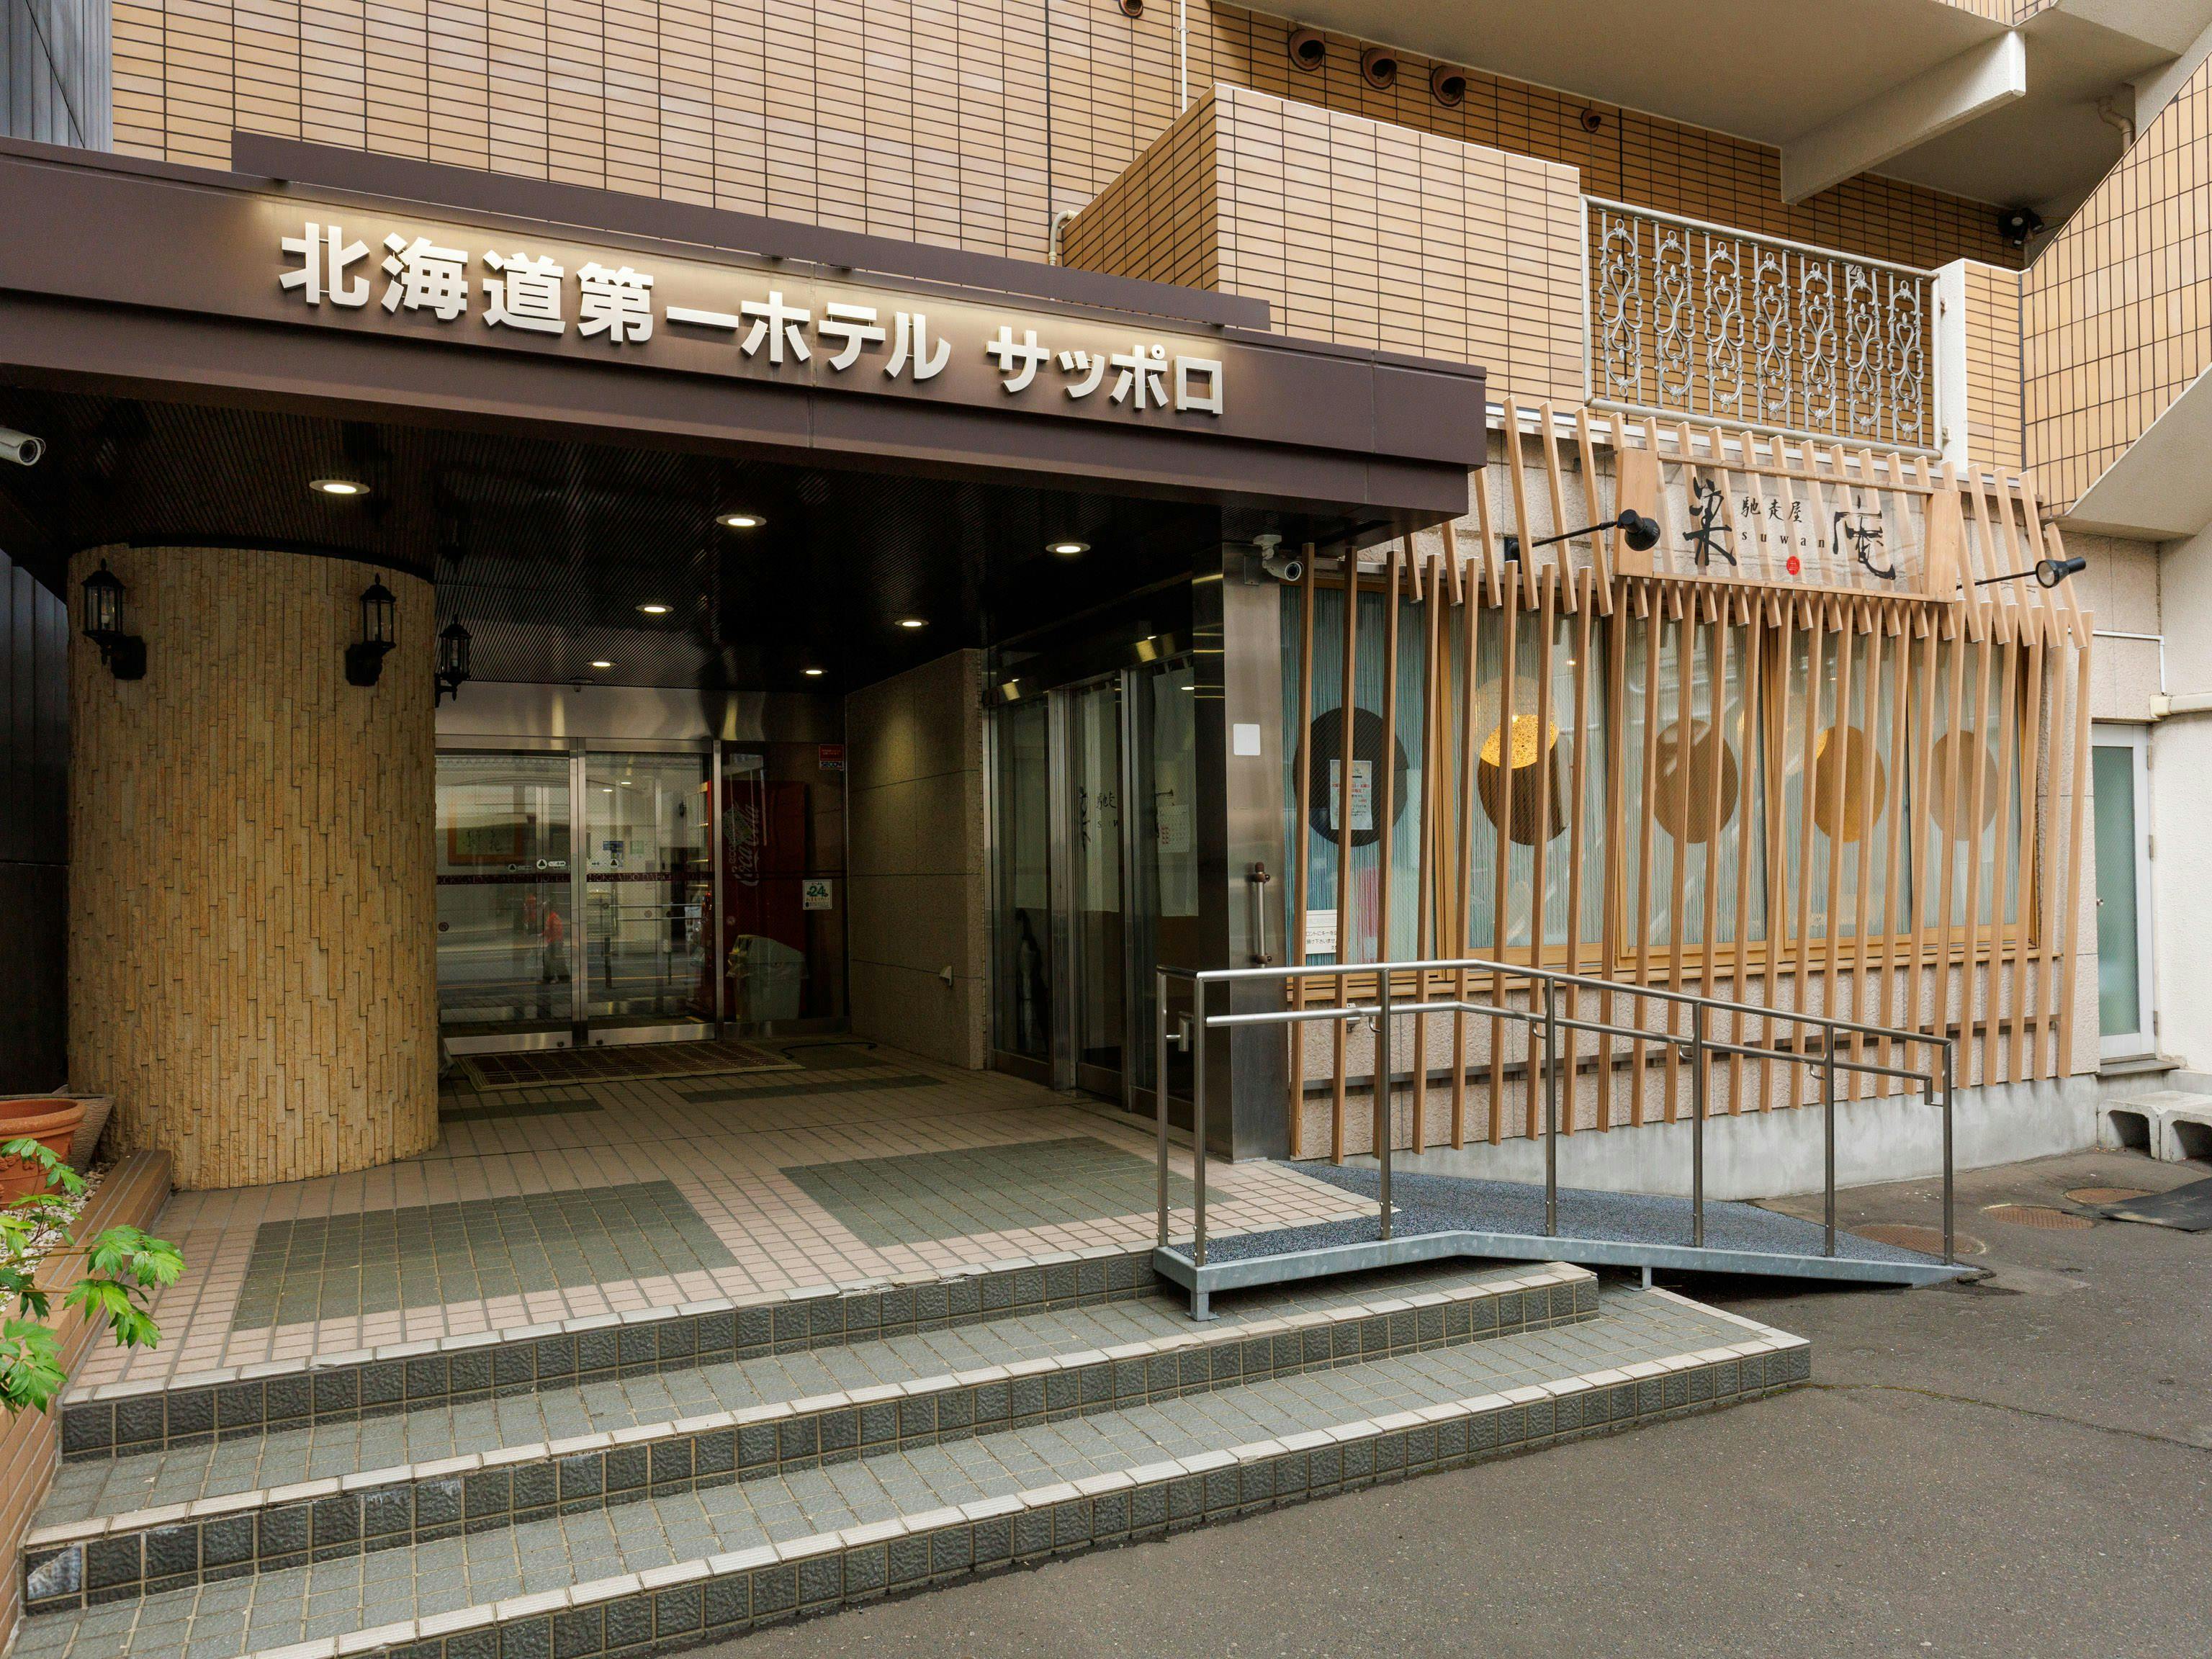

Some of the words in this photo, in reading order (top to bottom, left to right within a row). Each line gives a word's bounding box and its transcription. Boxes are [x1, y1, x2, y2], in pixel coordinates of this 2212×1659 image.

[279, 221, 952, 382] 北海道第一ホテル
[986, 324, 1225, 416] サッポロ
[1740, 496, 1802, 523] 馳走屋
[1742, 531, 1825, 548] suwan
[809, 886, 824, 896] 24
